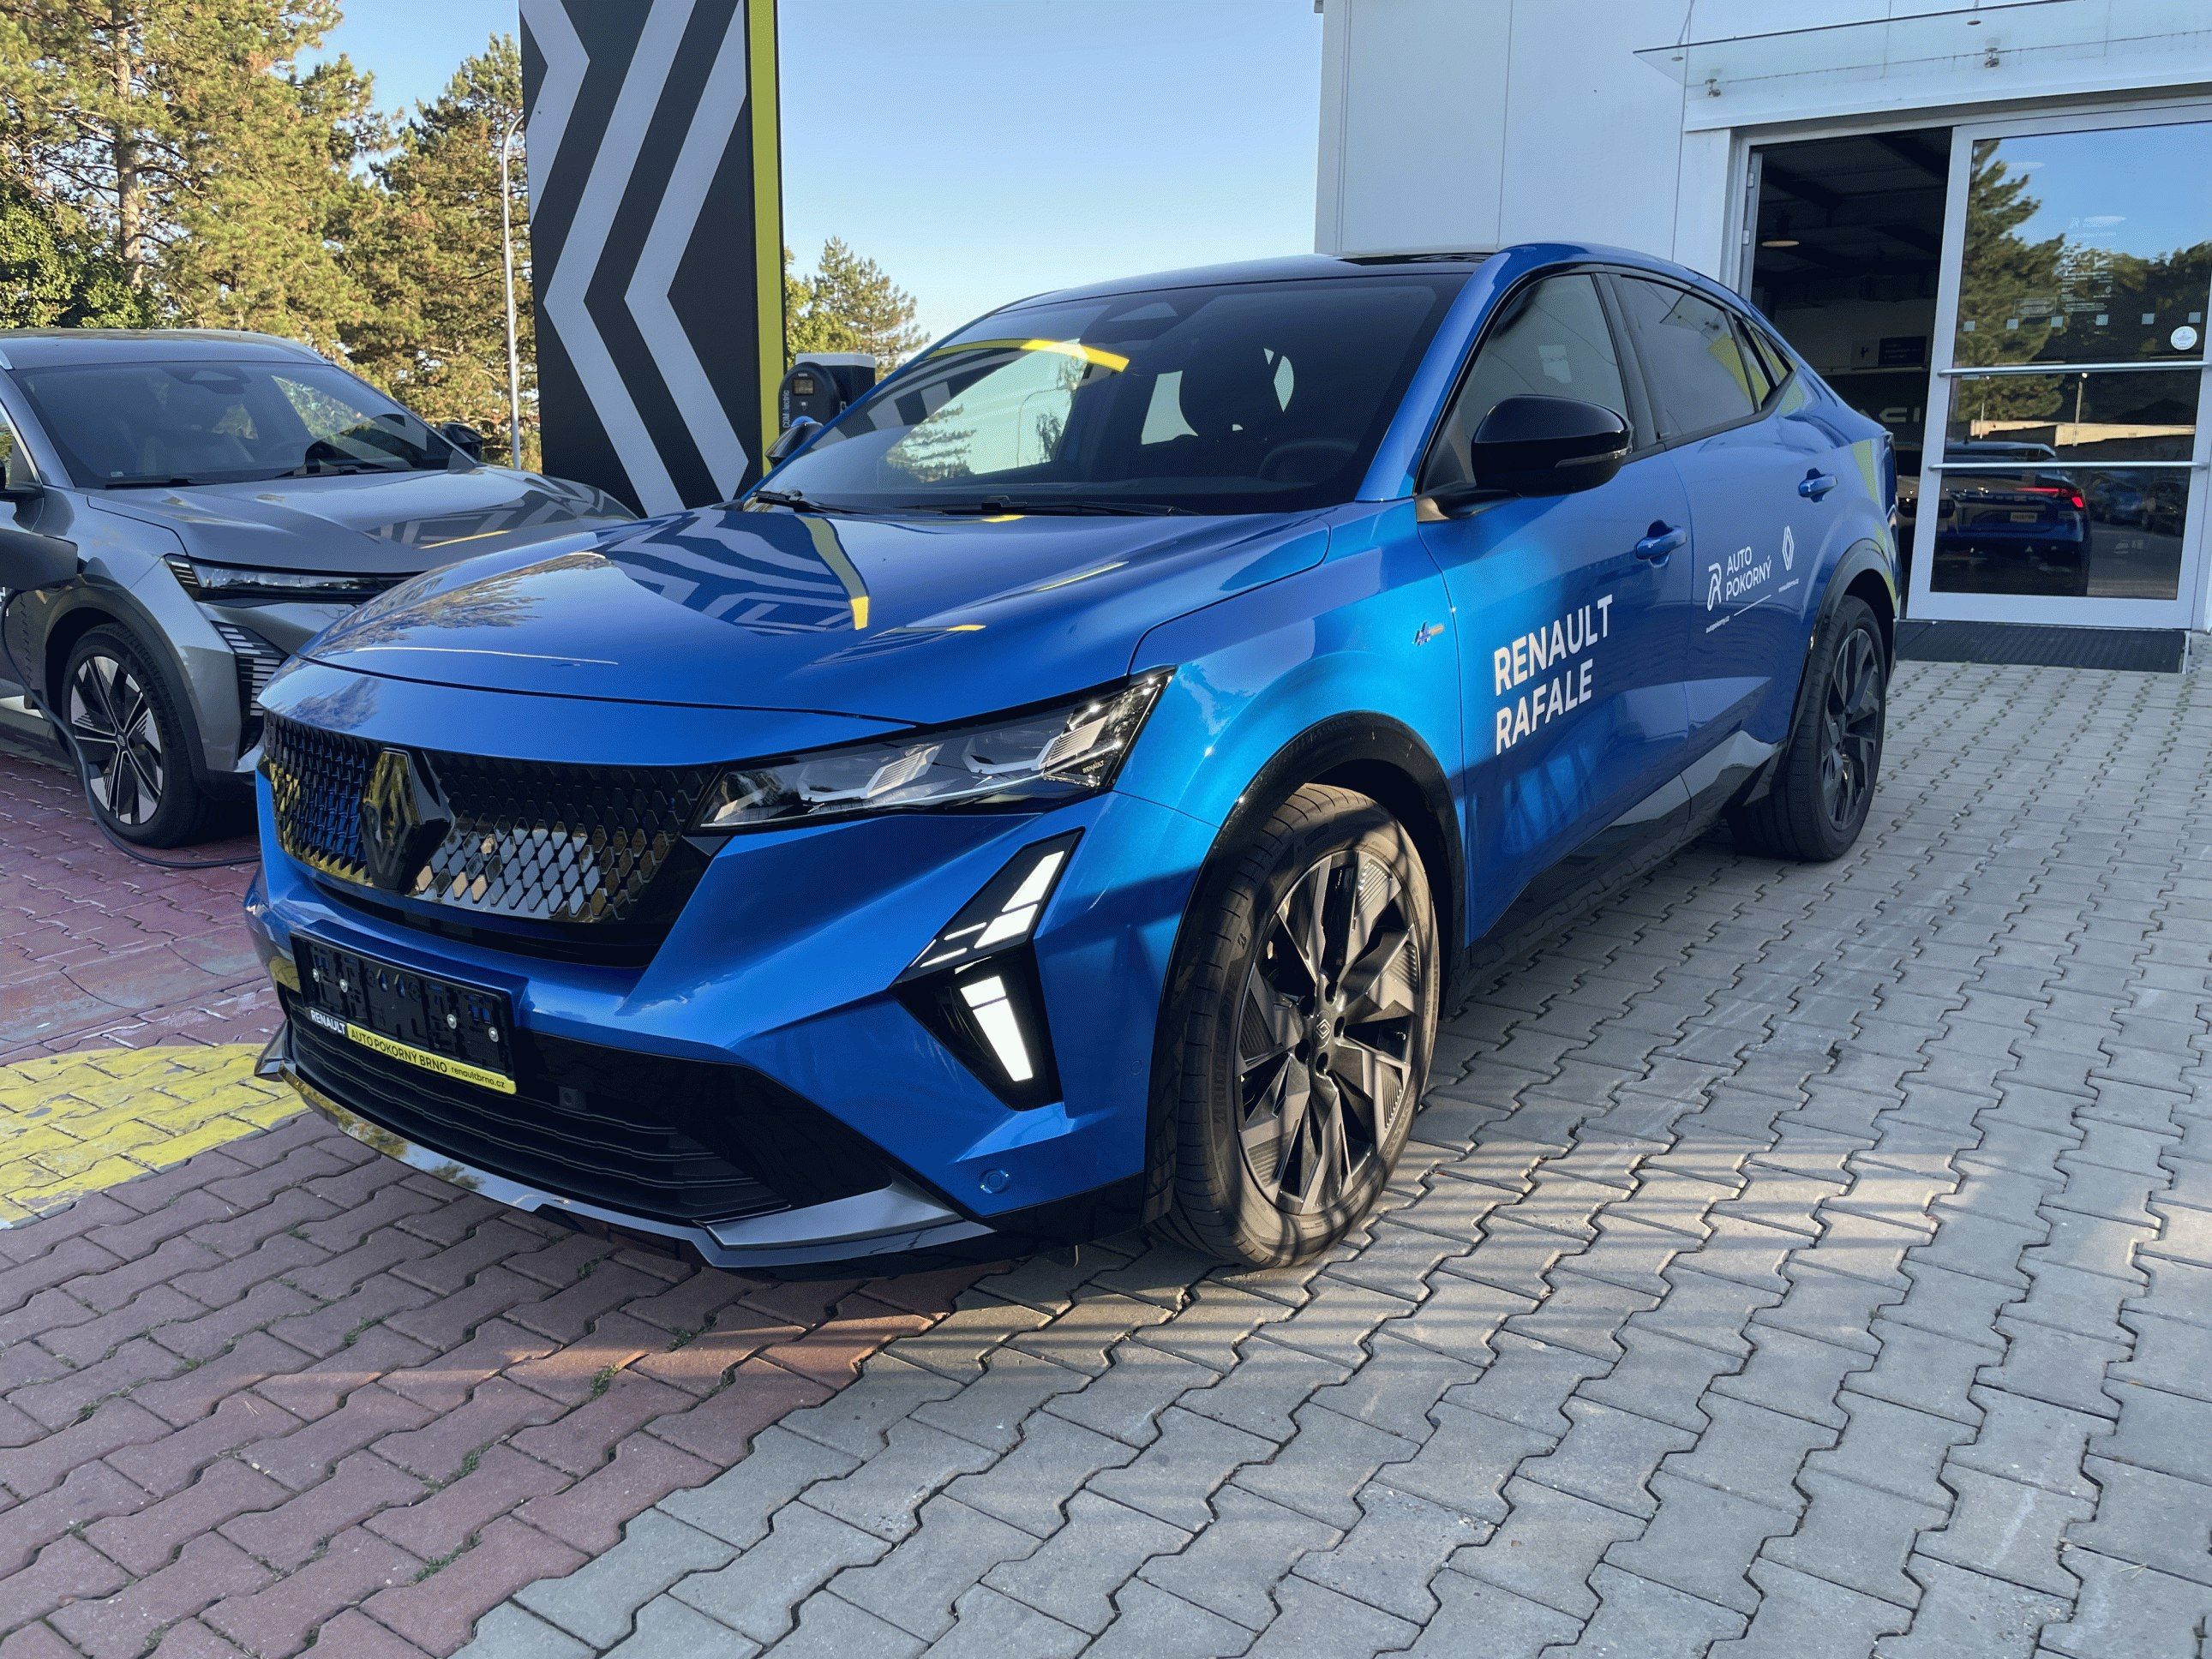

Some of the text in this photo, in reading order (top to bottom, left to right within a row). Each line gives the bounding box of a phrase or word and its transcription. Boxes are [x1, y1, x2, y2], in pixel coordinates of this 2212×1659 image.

[1726, 546, 1753, 576] AUTO
[1726, 555, 1772, 601] POKORNÝ
[1494, 594, 1613, 697] RENAULT
[1496, 658, 1593, 756] RAFALE
[310, 1009, 506, 1089] RENAULT AUTO POKORNÝ BRNO renaultbrno.cz
